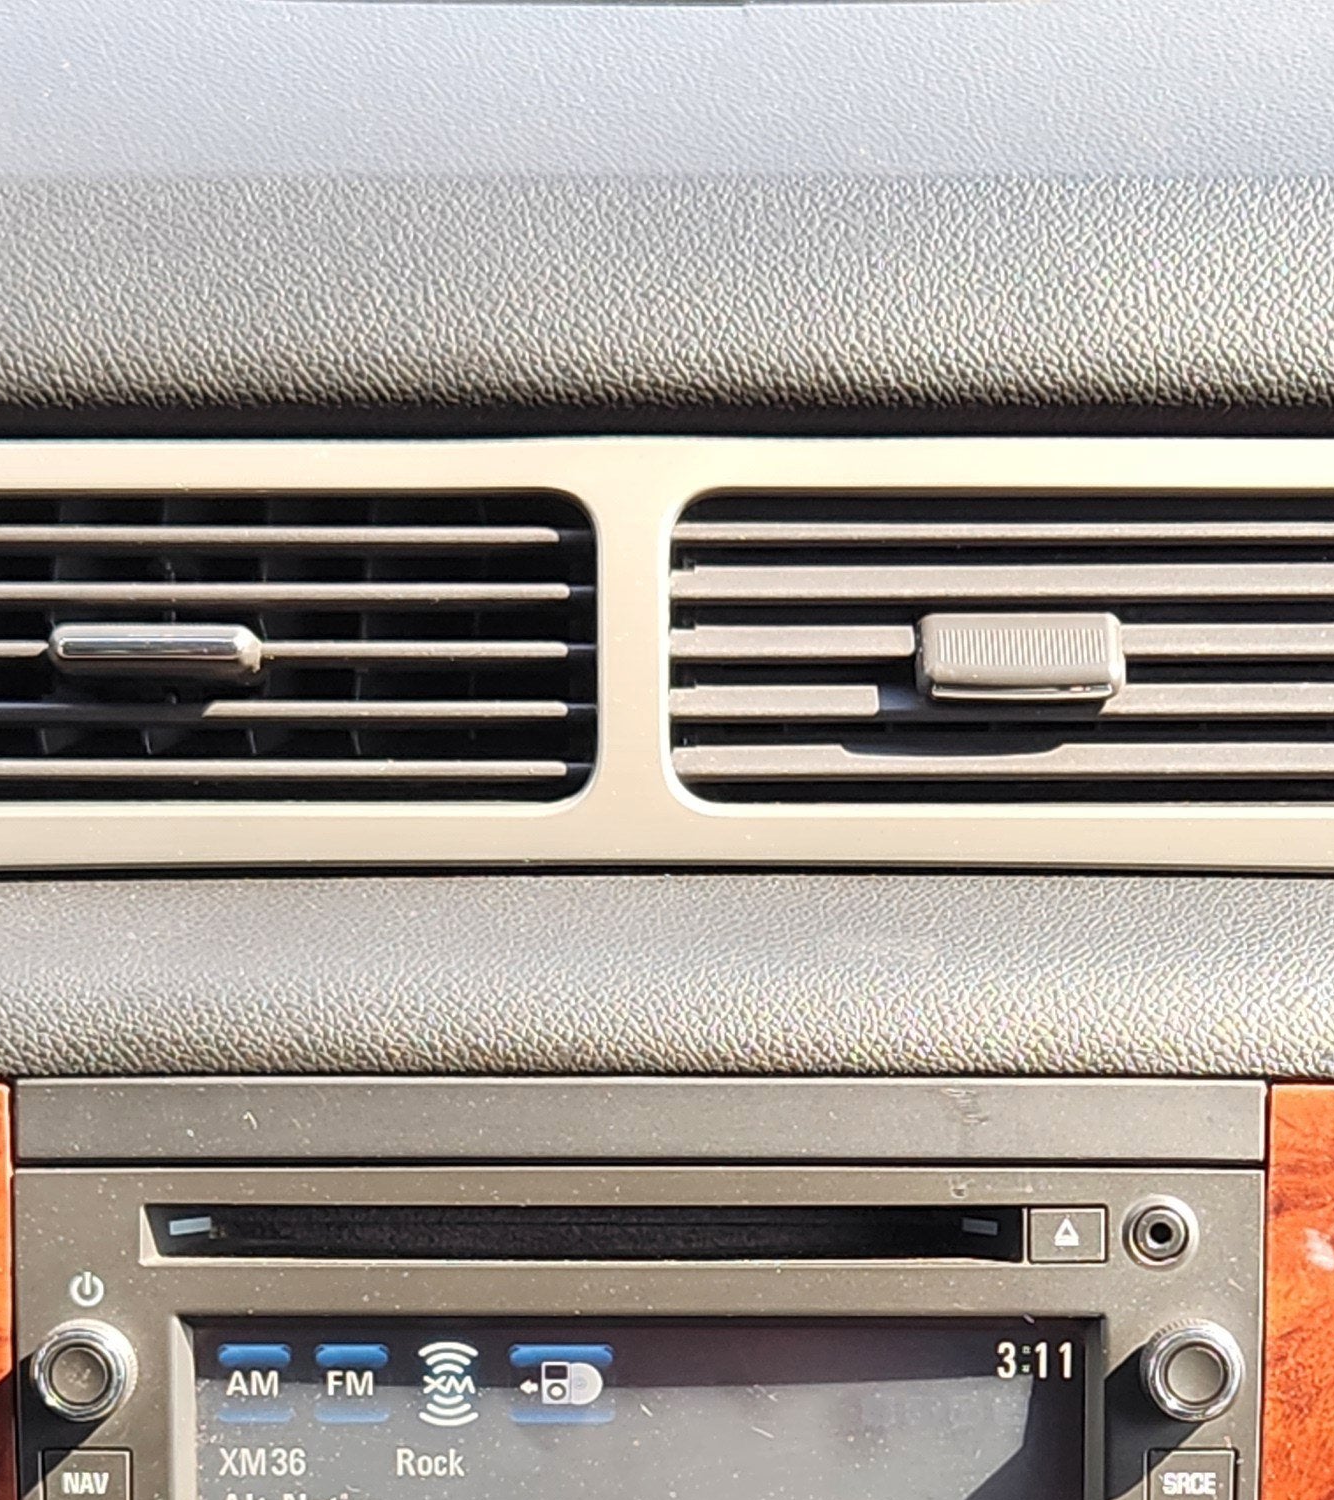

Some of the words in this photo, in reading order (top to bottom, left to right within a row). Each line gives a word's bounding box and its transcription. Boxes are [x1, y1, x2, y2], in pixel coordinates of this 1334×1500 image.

[996, 1342, 1073, 1379] 3:11
[226, 1370, 279, 1397] AM
[327, 1370, 375, 1396] FM
[396, 1448, 466, 1477] Rock
[62, 1472, 109, 1494] NAV
[1162, 1472, 1216, 1495] SRCE
